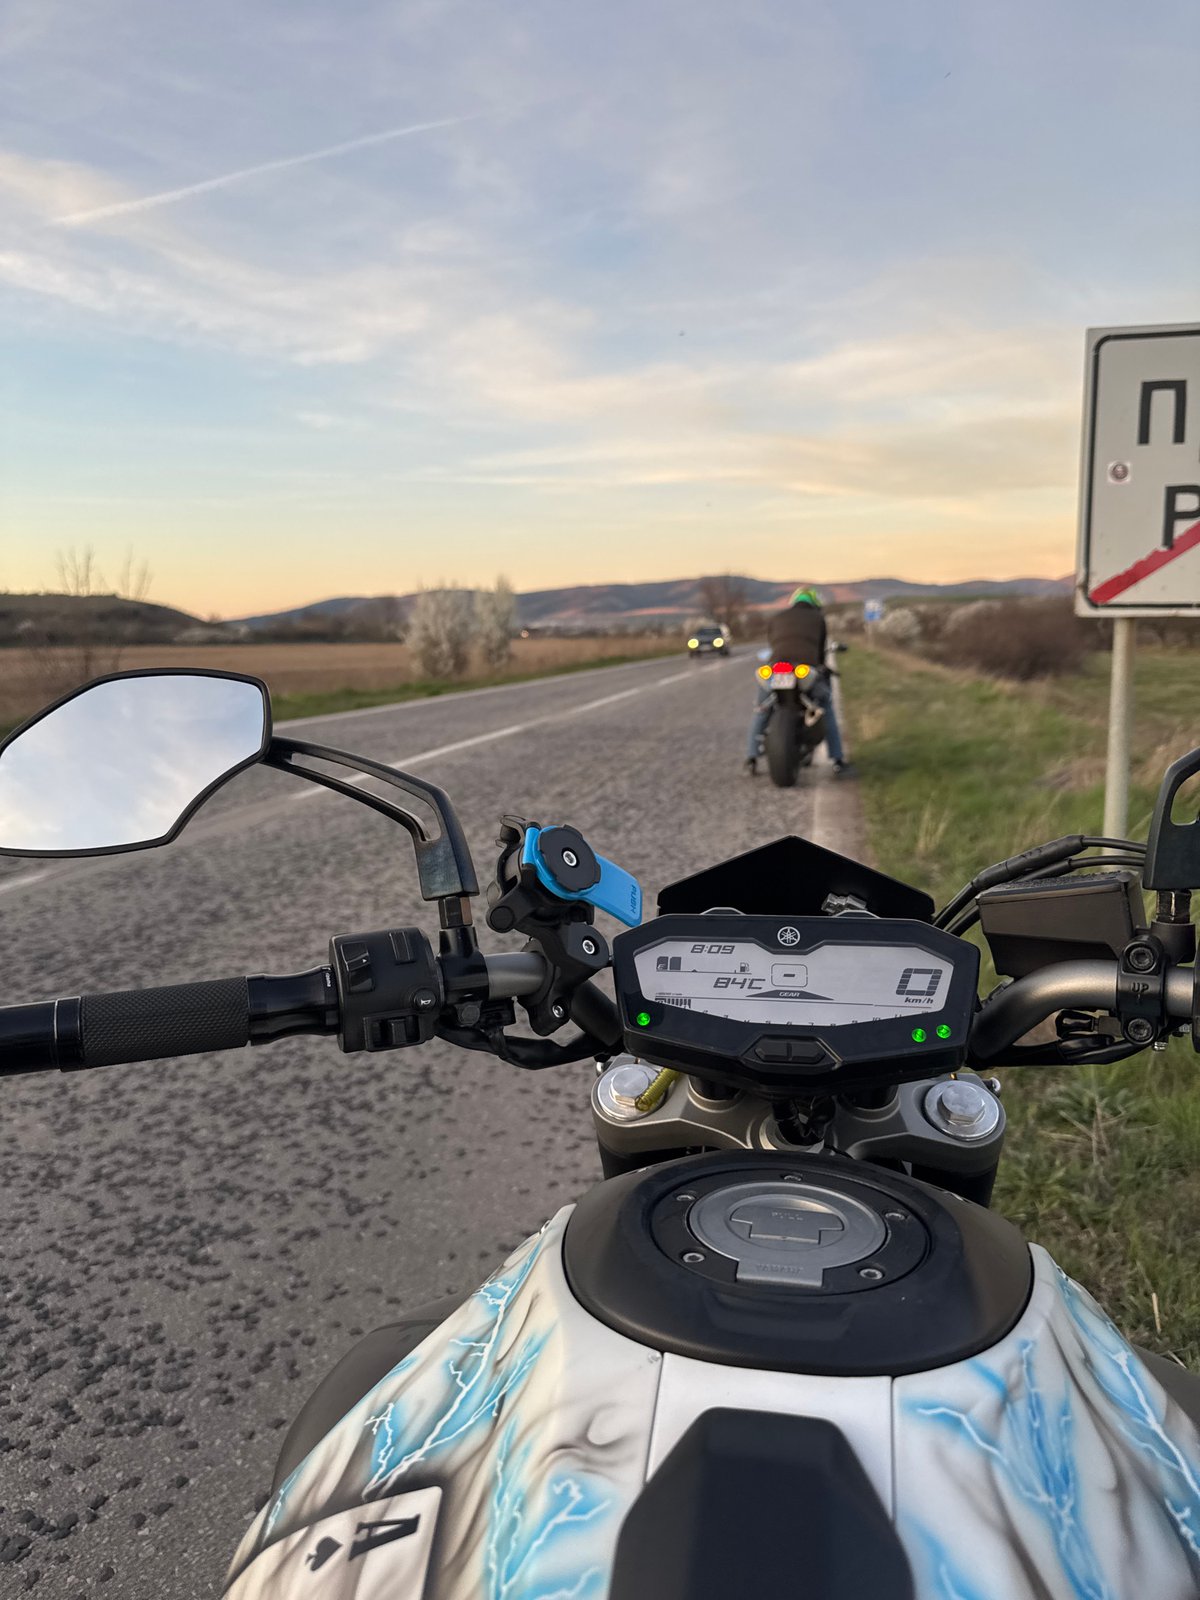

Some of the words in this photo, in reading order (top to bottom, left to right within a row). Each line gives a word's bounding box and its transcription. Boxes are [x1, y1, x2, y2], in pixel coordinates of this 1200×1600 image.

[690, 944, 735, 954] 8:09
[895, 967, 943, 996] 0
[1131, 982, 1150, 993] UP
[349, 1513, 421, 1562] A
